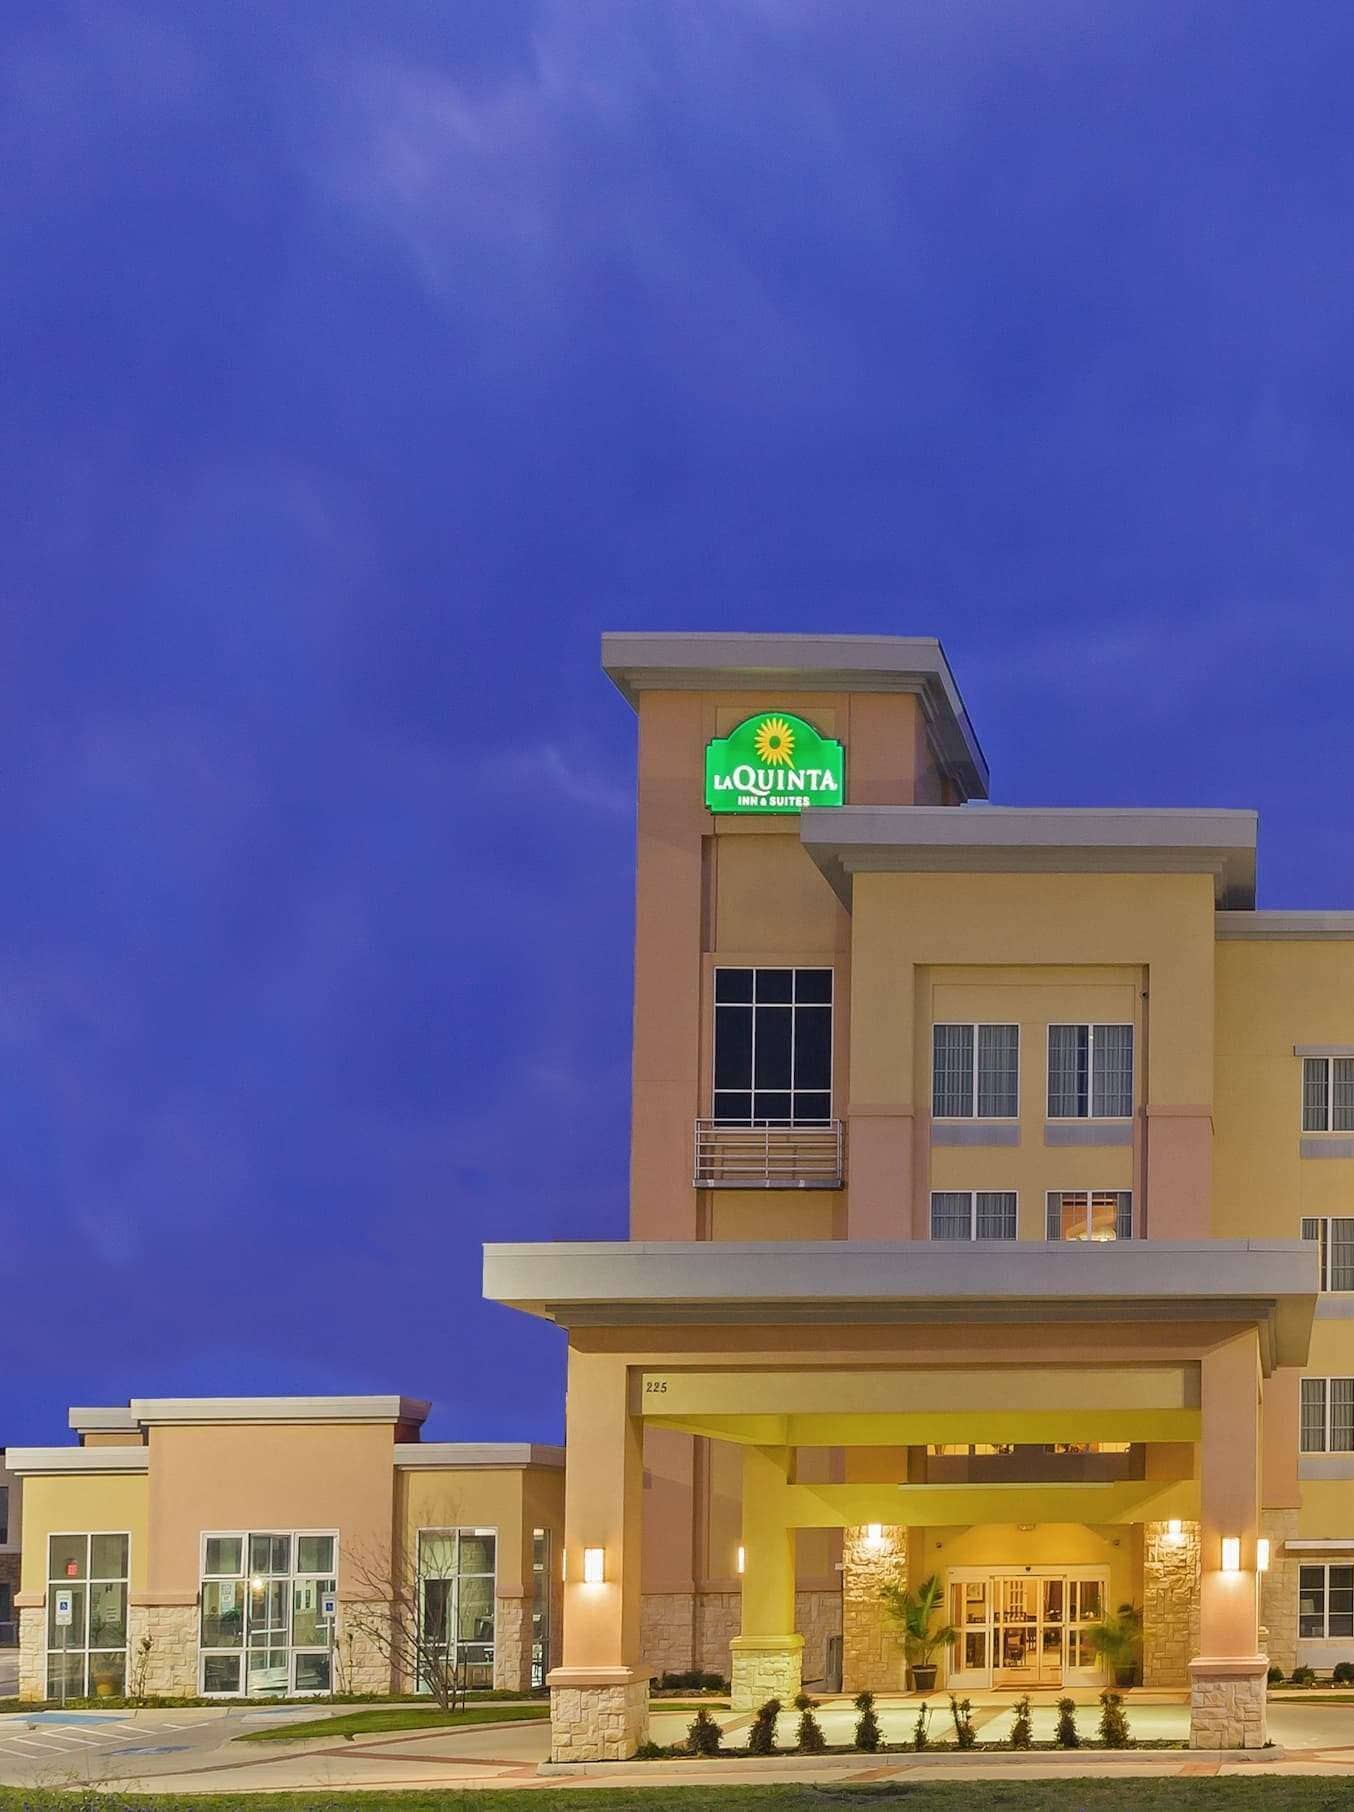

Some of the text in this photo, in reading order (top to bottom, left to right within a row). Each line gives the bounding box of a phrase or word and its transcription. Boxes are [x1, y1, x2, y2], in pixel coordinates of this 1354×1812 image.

[737, 796, 811, 807] INN & SUITES
[646, 1381, 667, 1393] 225
